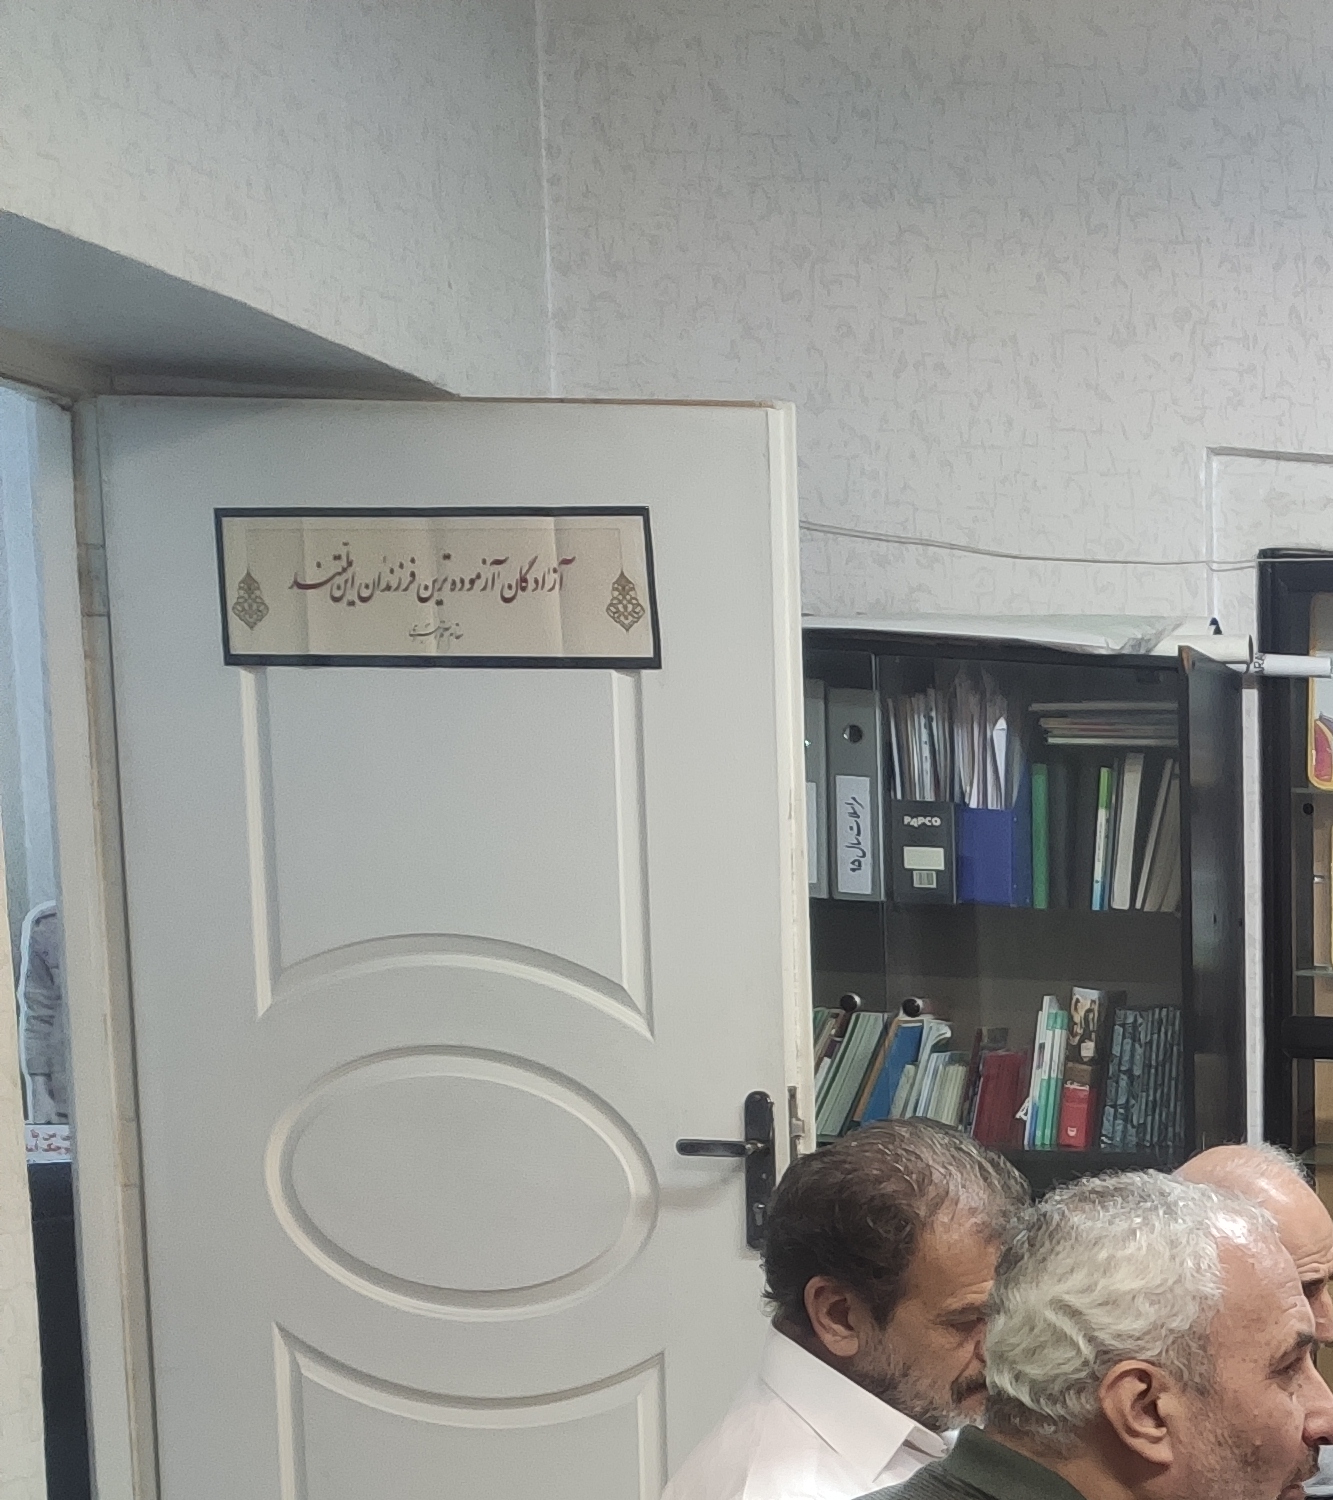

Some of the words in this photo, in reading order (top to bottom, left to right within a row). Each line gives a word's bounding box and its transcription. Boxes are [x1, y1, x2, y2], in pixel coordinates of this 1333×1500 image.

[357, 556, 417, 603] فرزندان
[450, 556, 510, 592] آزموده
[501, 555, 576, 604] آزادگان
[903, 815, 942, 828] PAPCO
